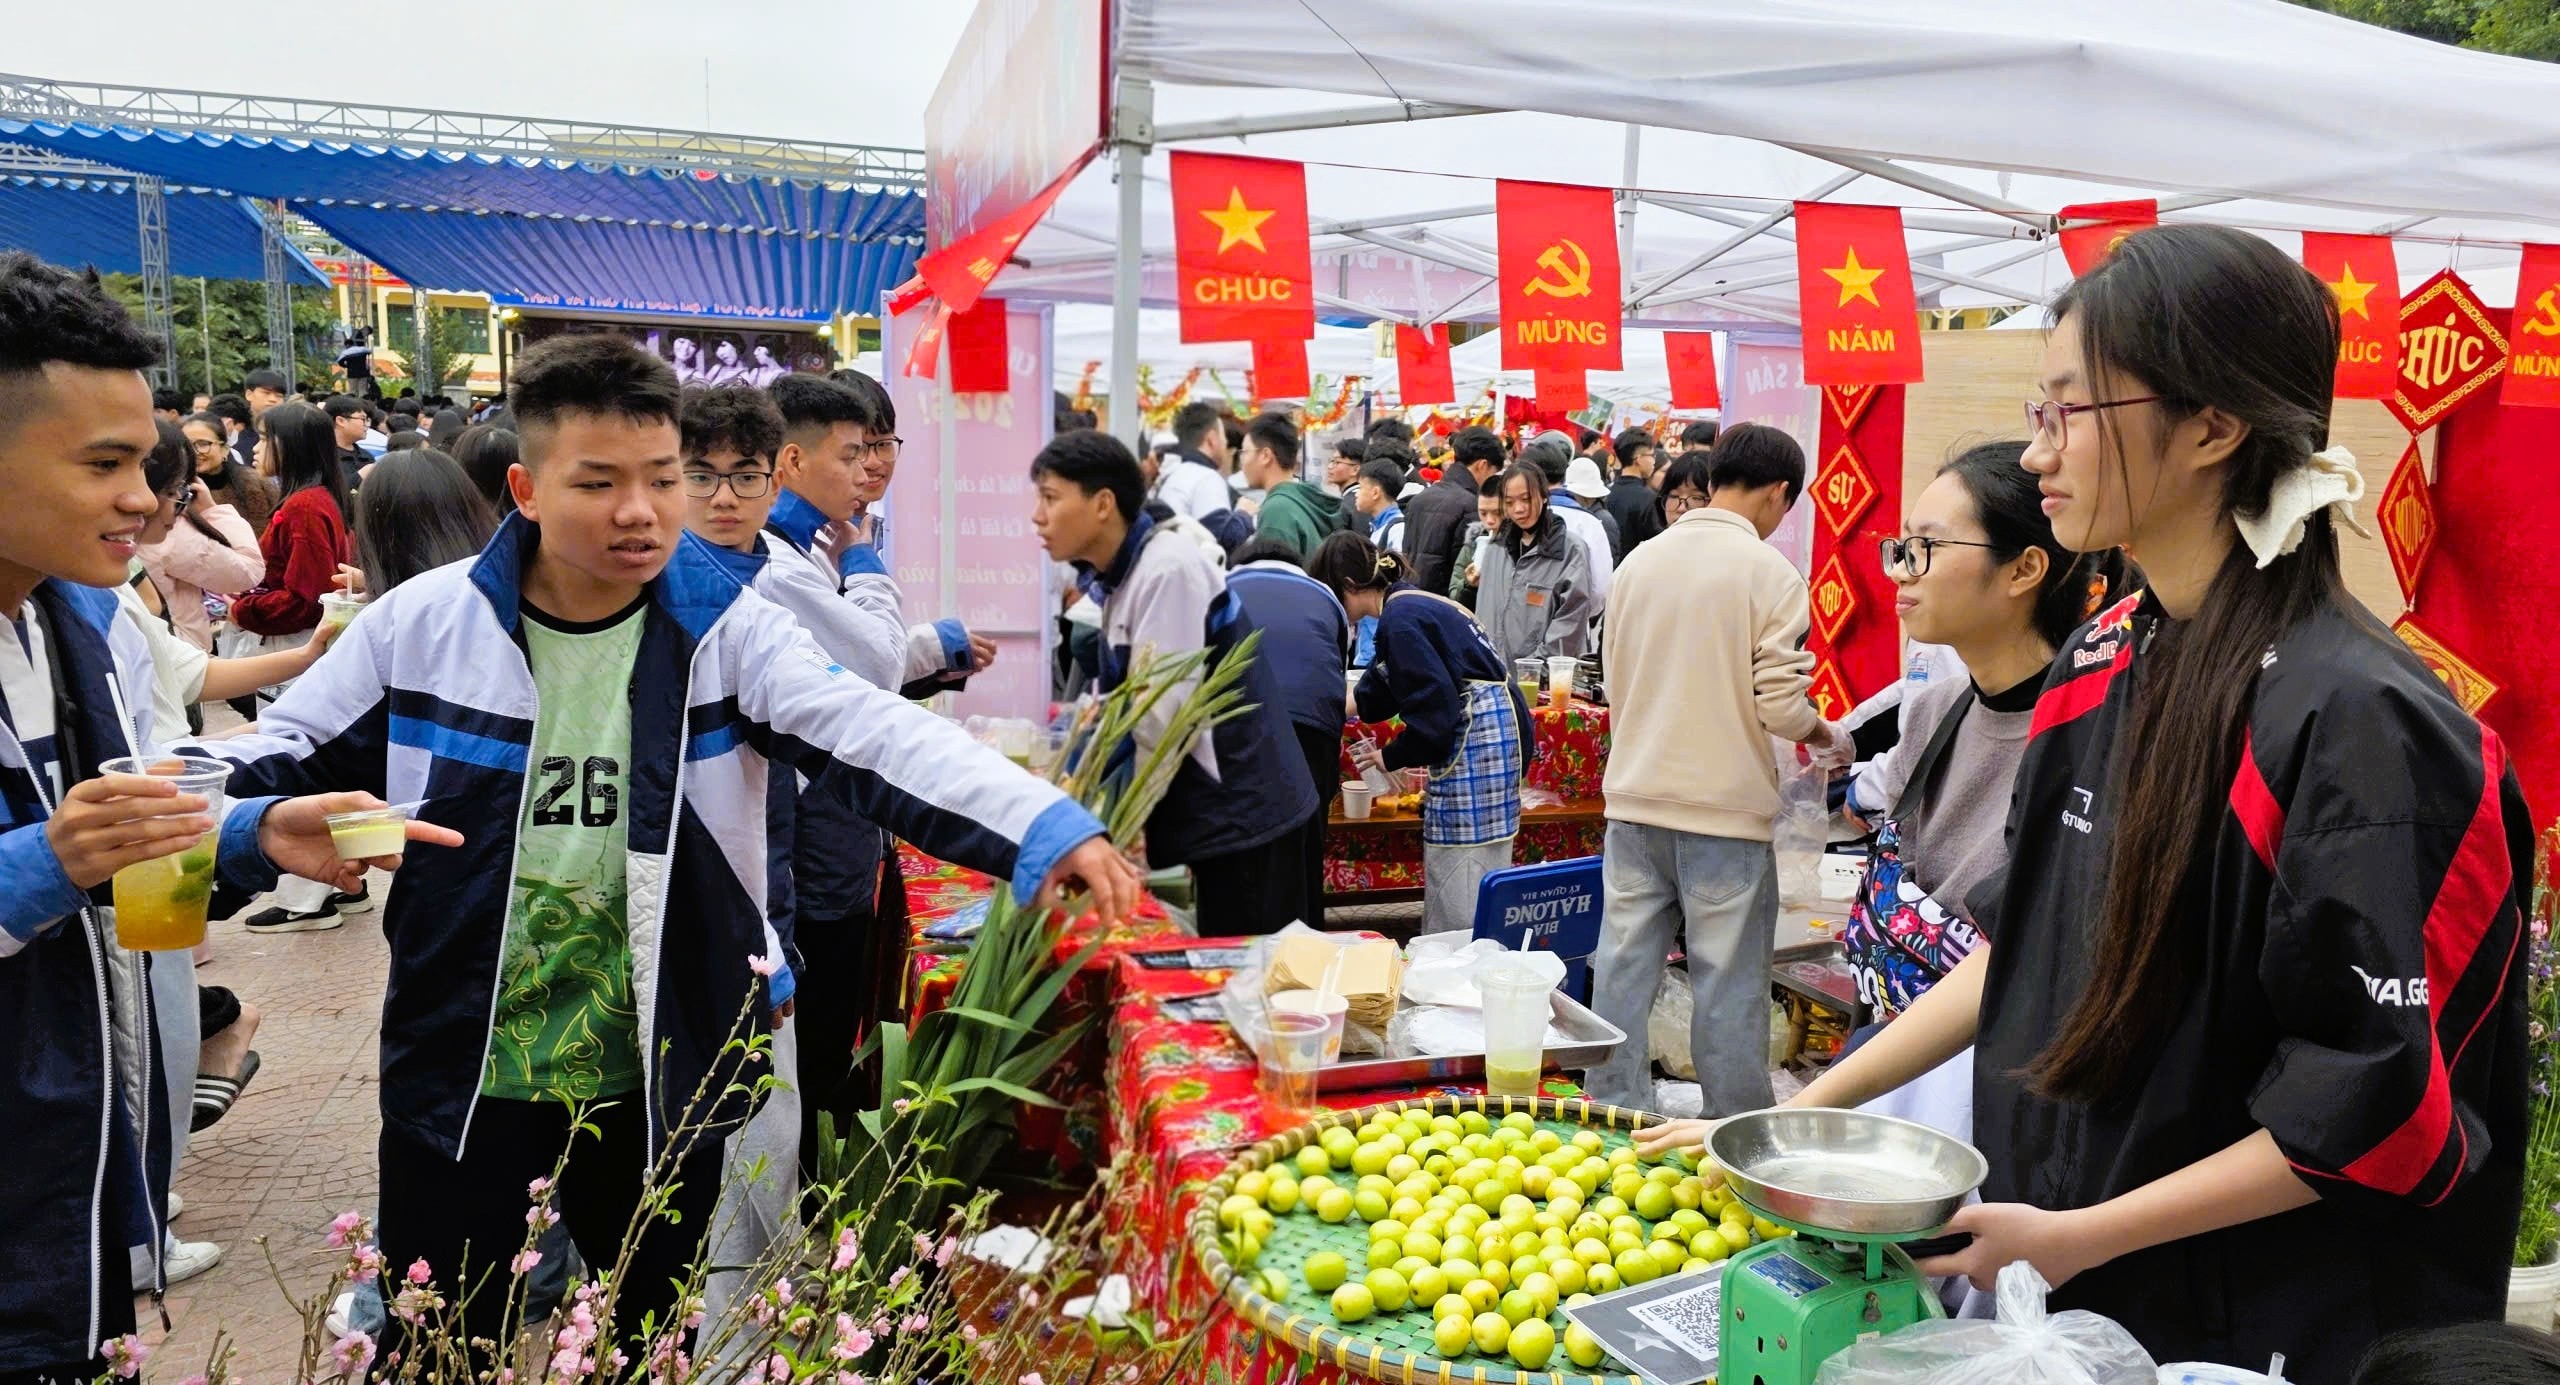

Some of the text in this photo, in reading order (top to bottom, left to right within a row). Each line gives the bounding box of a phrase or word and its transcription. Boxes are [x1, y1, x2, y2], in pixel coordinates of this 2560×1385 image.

[1194, 270, 1292, 303] CHÚC
[1518, 312, 1607, 345] MỪNG
[1827, 323, 1895, 352] NĂM
[1827, 471, 1857, 511] SỰ
[1818, 580, 1844, 618] NHƯ
[533, 755, 619, 828] 26
[1521, 892, 1538, 901] BIA
[1540, 886, 1567, 898] QUAN
[1504, 893, 1593, 928] HALONG
[1533, 919, 1560, 937] BIA
